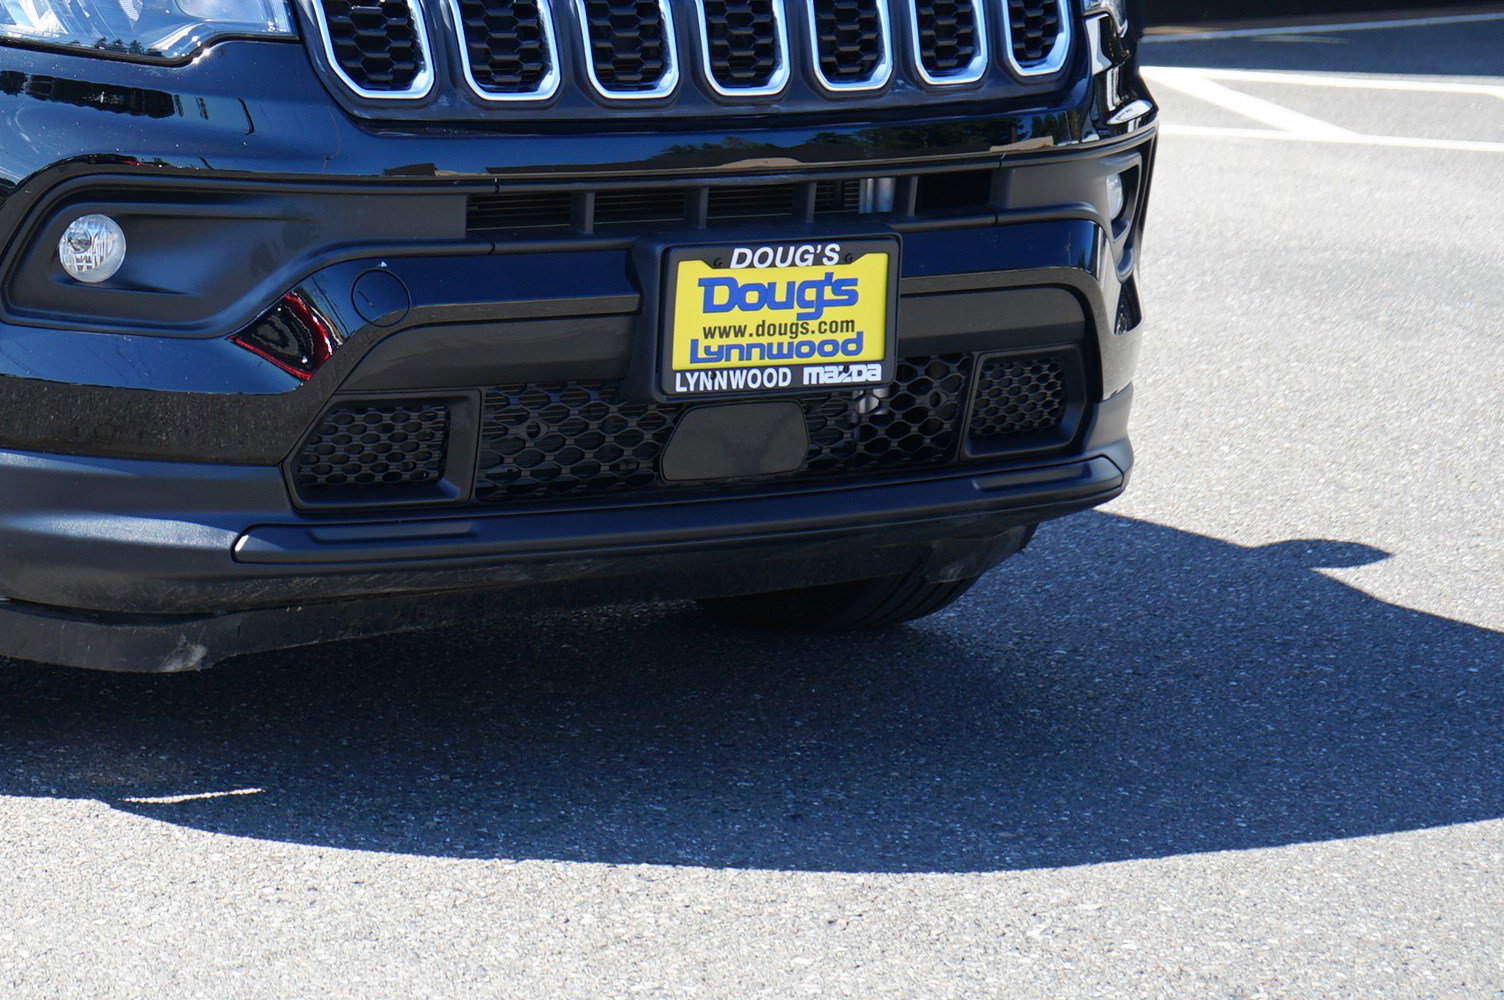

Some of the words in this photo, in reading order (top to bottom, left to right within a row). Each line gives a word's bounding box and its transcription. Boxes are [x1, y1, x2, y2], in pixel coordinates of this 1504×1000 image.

[729, 243, 841, 270] DOUG'S
[698, 272, 859, 321] Doug's
[702, 319, 856, 340] www.dougs.com
[690, 331, 864, 364] Lynnwood
[675, 367, 792, 392] LYNNWOOD
